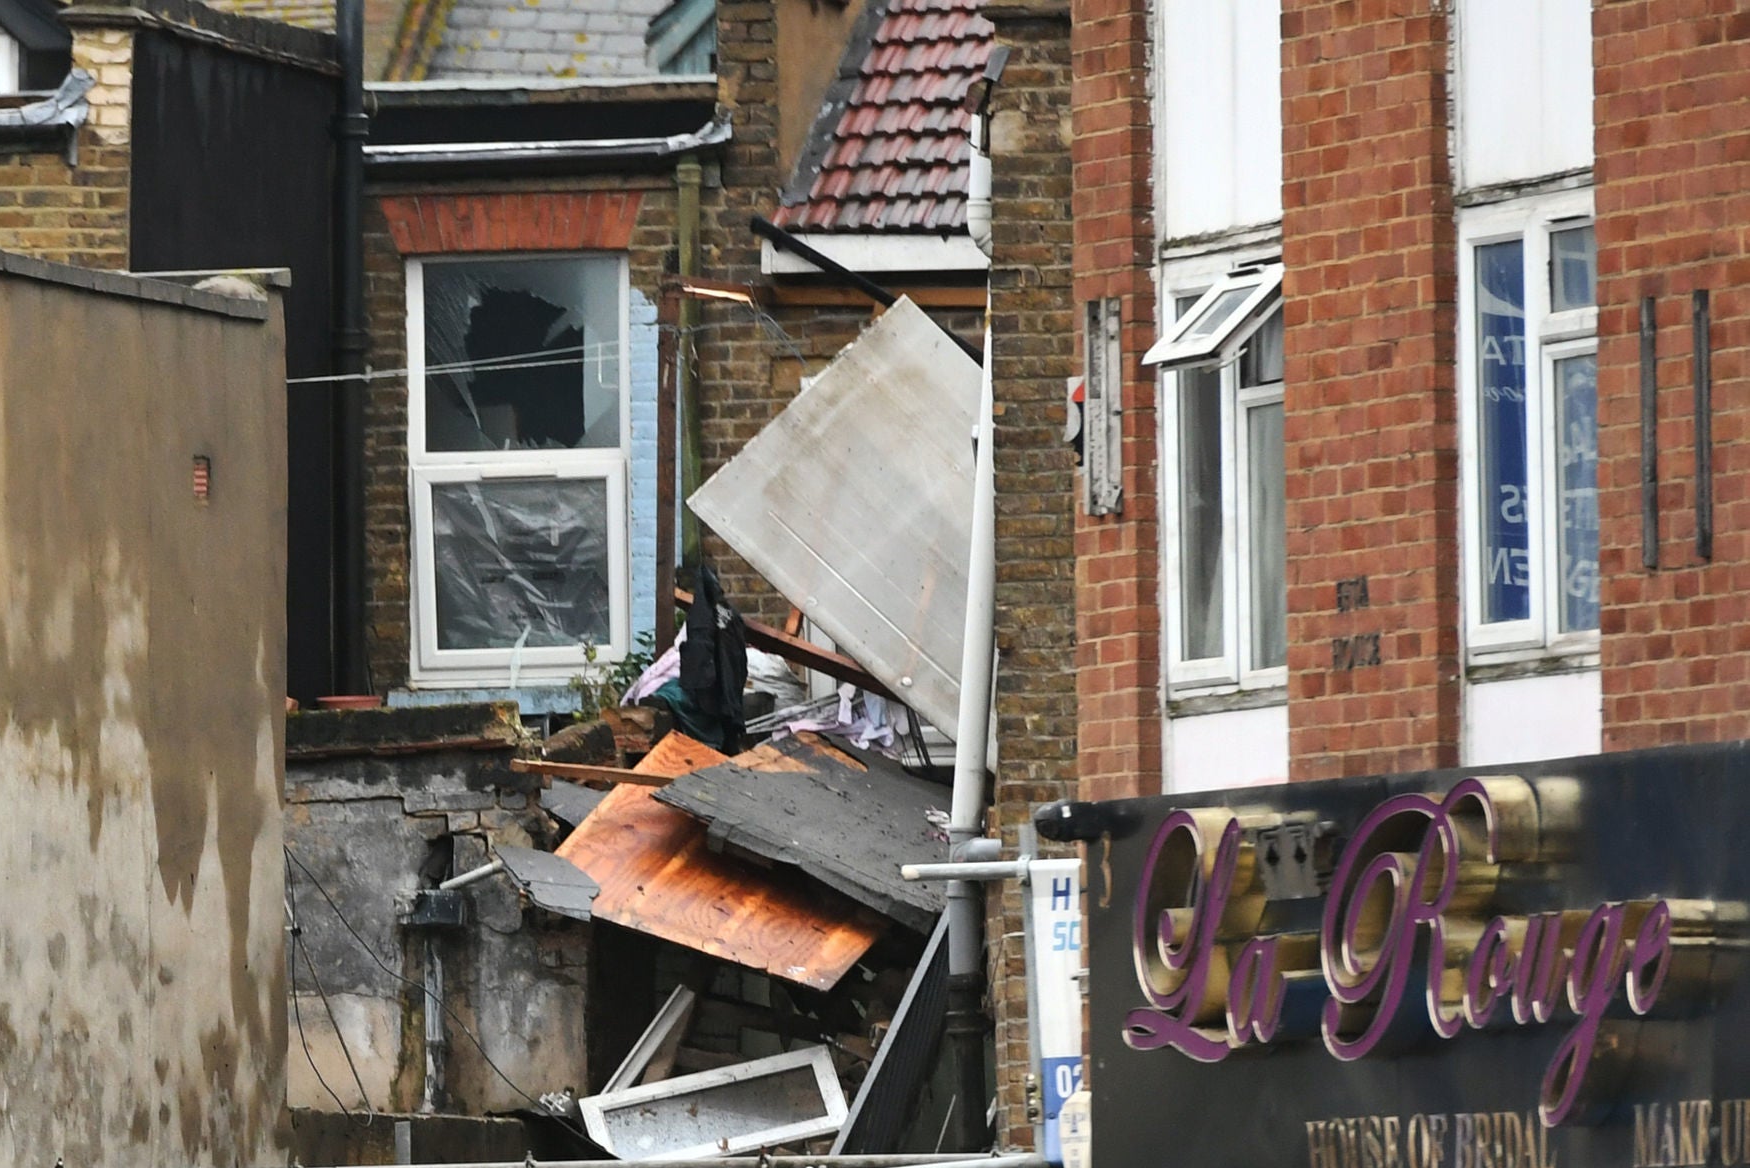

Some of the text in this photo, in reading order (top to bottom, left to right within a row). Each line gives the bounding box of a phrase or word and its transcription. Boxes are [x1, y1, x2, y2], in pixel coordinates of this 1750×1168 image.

[1122, 776, 1673, 1127] La Rouge
[1720, 1098, 1750, 1166] U
